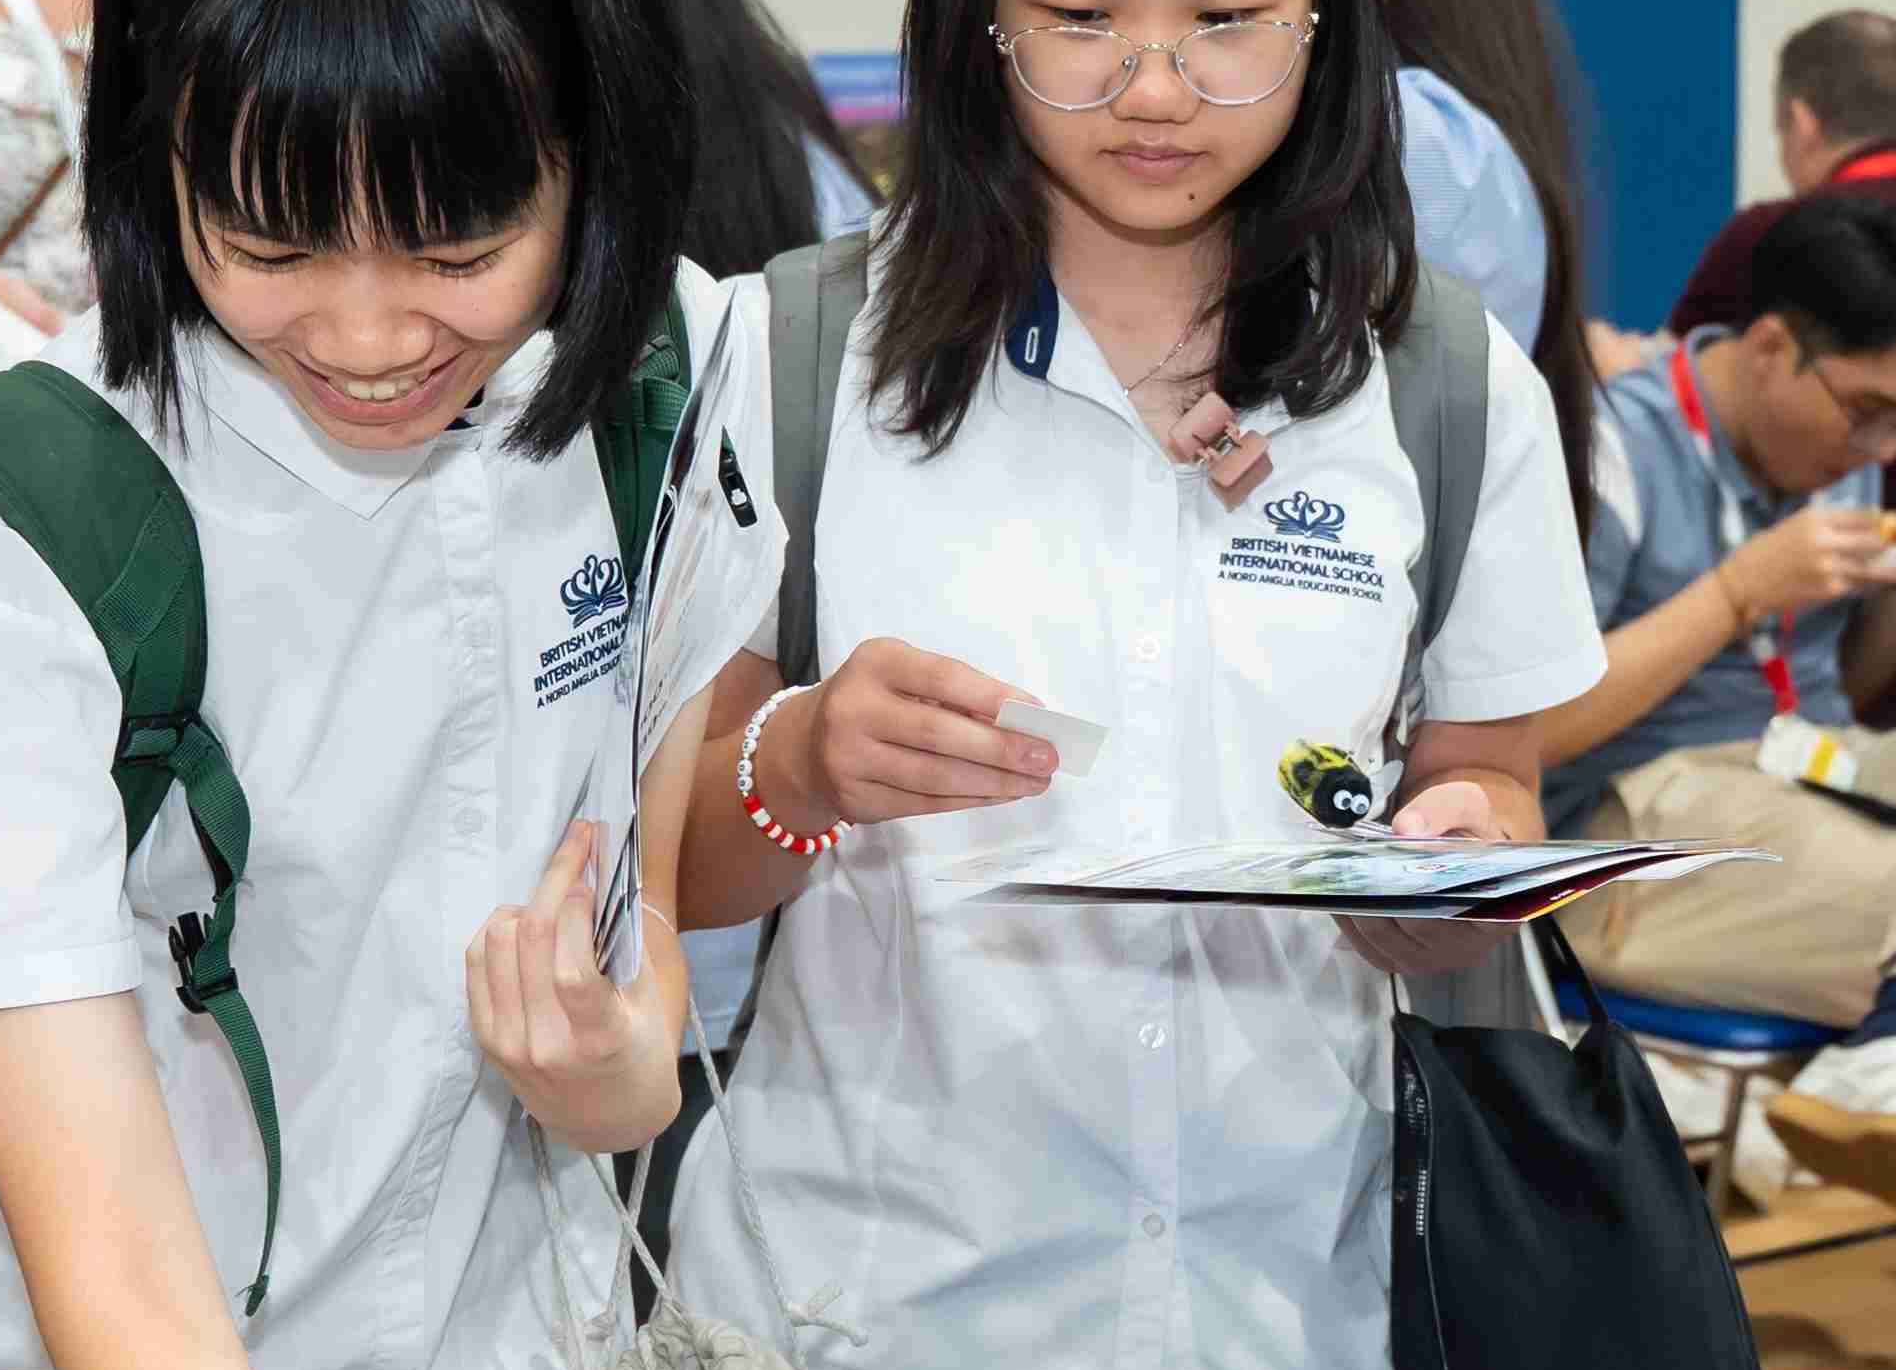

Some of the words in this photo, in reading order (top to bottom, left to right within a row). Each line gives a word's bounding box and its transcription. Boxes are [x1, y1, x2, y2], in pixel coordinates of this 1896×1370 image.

[1219, 552, 1330, 579] INTERNATIONAL
[1332, 567, 1385, 588] SCHOOL
[1231, 537, 1288, 555] BRITISH
[1291, 542, 1376, 568] VIETNAMESE
[1217, 570, 1225, 579] A
[1227, 570, 1257, 582] NORD
[1258, 574, 1296, 588] ANGLIA
[1297, 579, 1350, 596] EDUCATION
[1351, 586, 1383, 603] SCHOOL
[539, 631, 586, 668] BRITISH
[588, 614, 630, 644] VIETNA
[533, 633, 621, 692] INTERNATIONAL
[537, 697, 545, 709] A
[546, 683, 571, 704] NORD
[571, 669, 600, 691] ANGLIA
